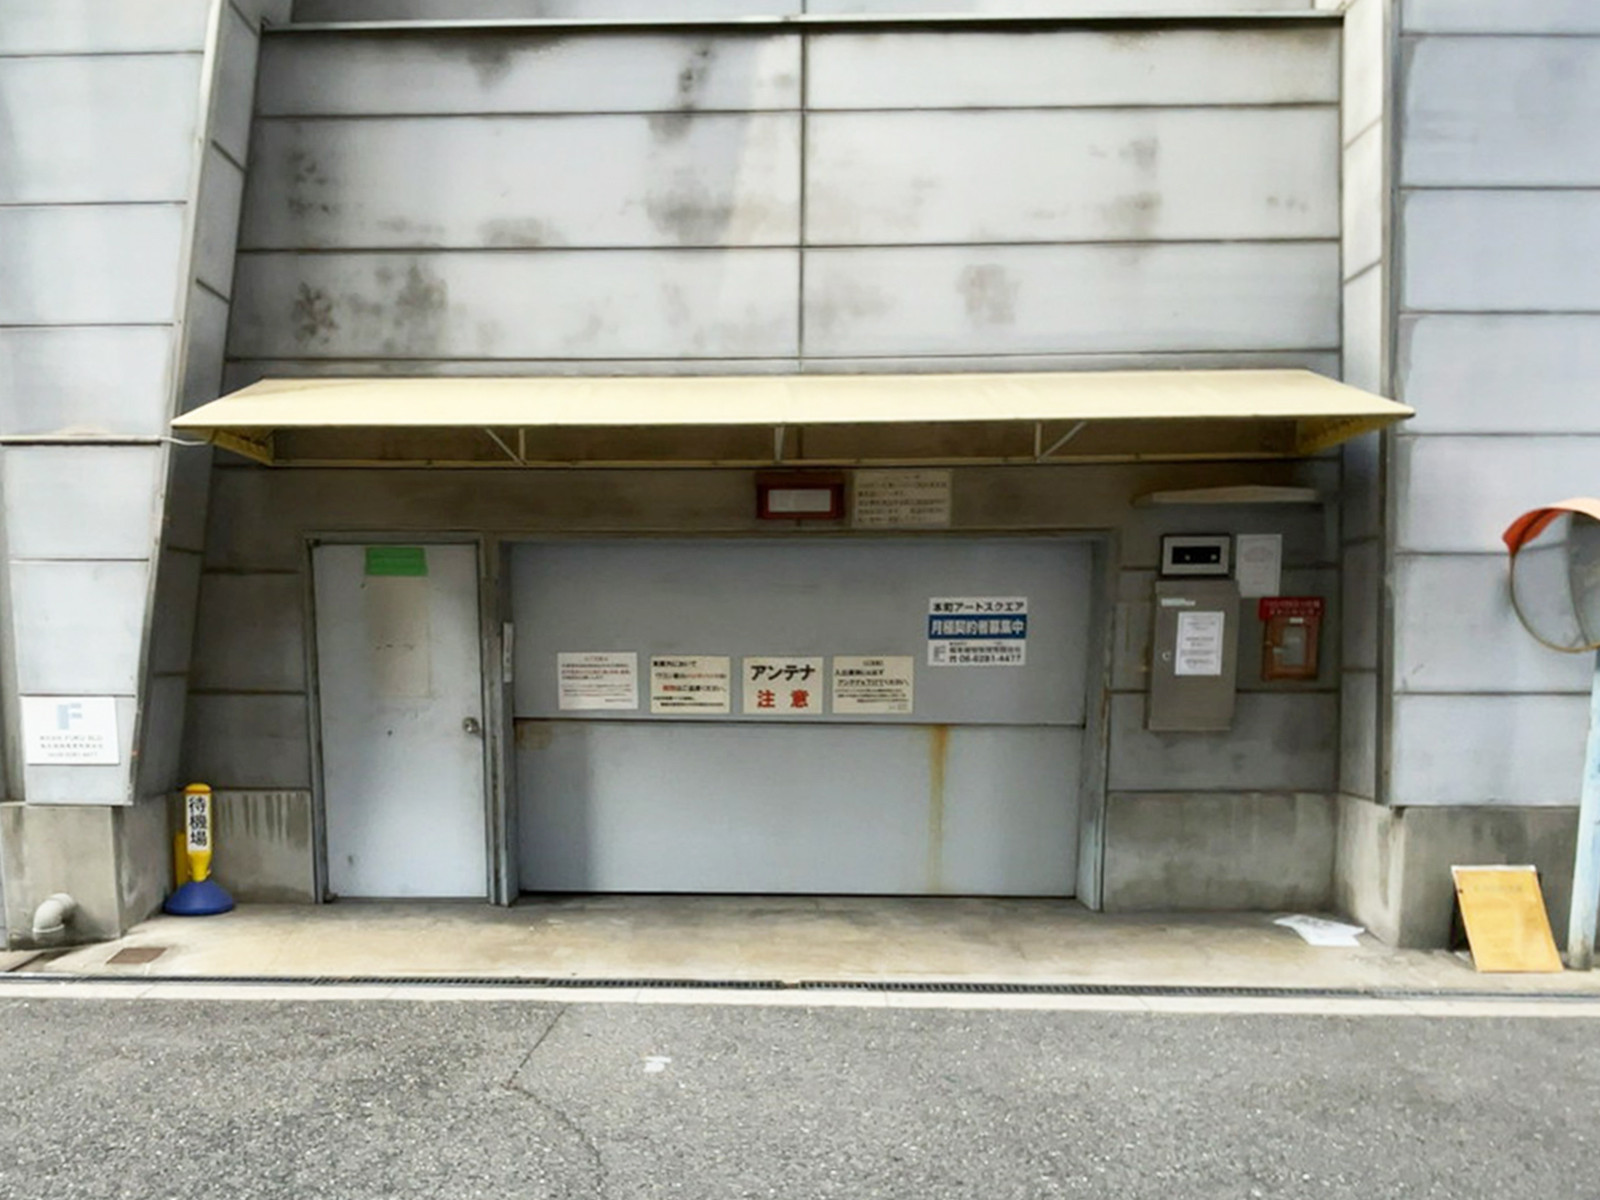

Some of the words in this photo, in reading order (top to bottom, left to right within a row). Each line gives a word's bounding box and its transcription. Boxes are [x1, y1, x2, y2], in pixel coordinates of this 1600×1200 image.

[751, 664, 815, 681] アンテナ
[188, 796, 208, 847] 待機場
